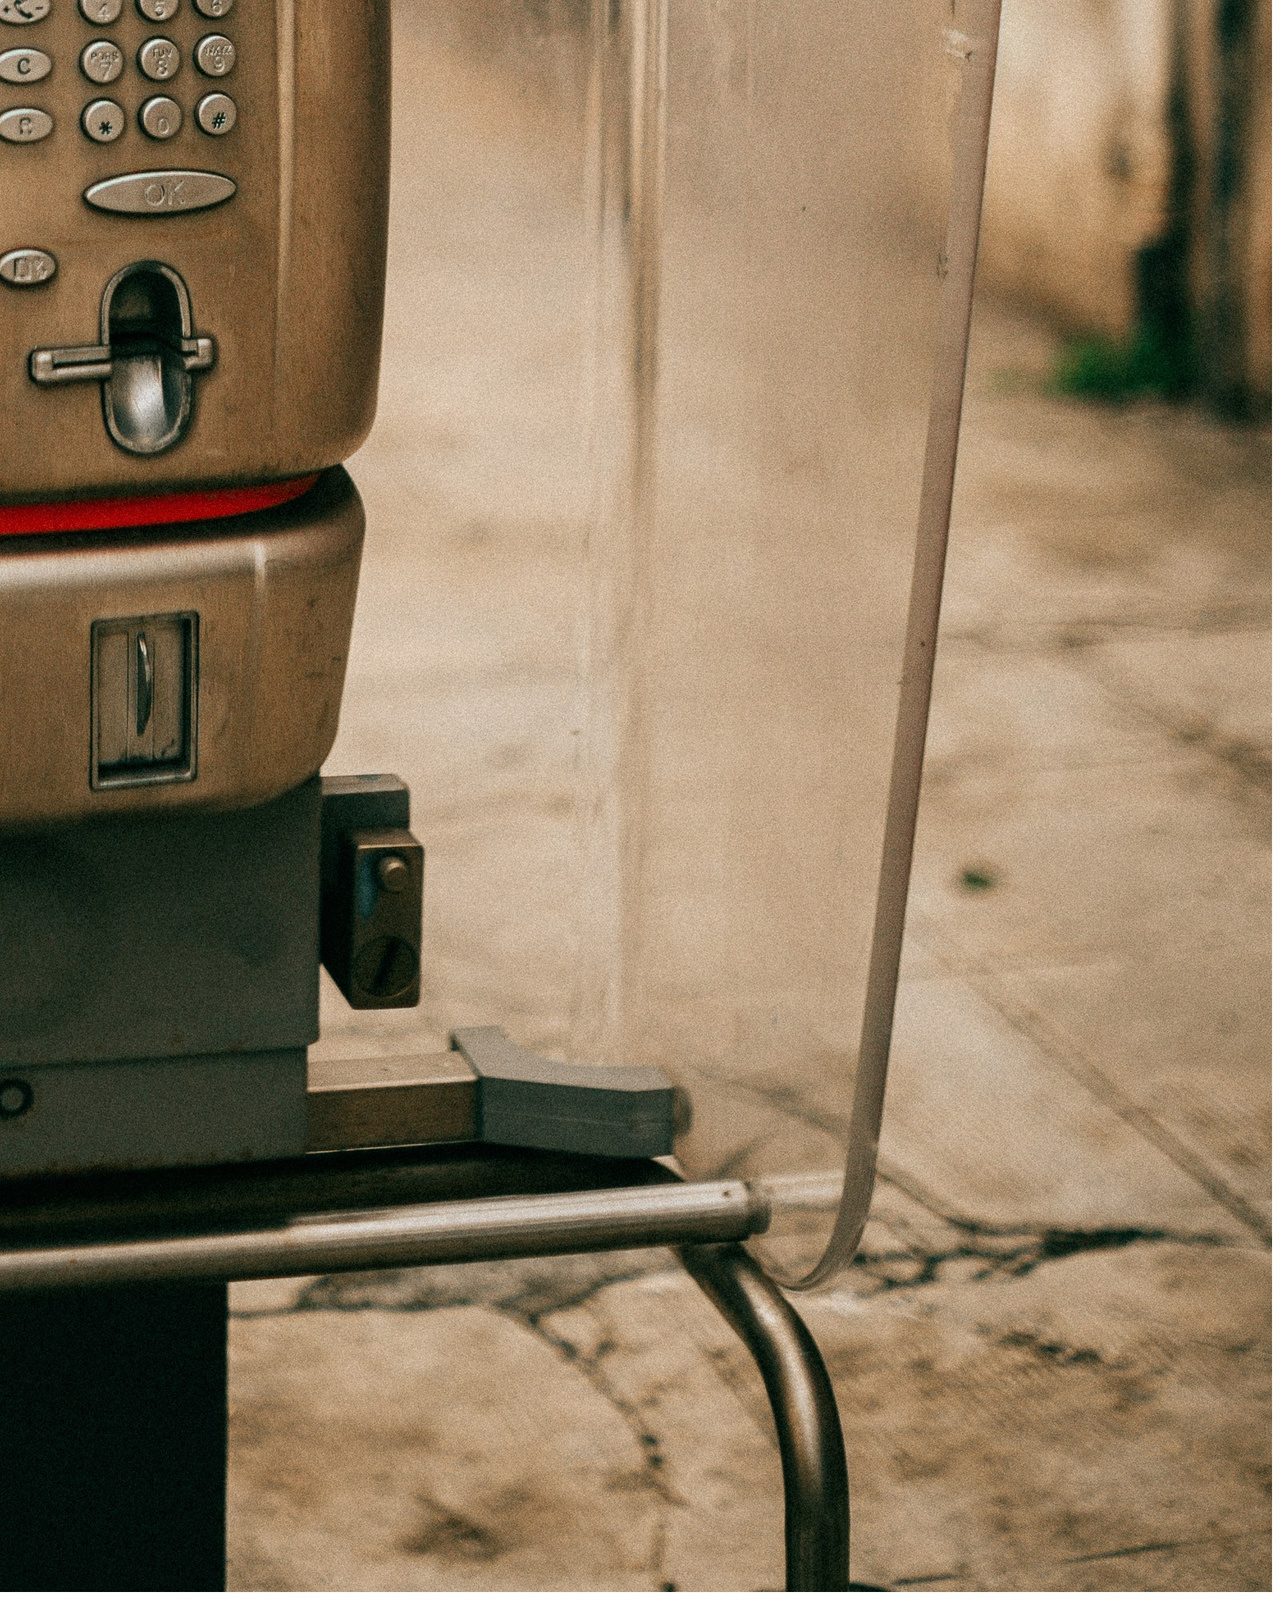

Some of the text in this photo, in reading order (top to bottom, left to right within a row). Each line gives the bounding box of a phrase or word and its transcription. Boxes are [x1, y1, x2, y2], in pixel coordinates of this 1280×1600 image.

[153, 1, 167, 18] 5
[17, 57, 31, 75] C
[99, 61, 114, 80] 7
[156, 58, 169, 77] 8
[213, 55, 225, 73] 9
[156, 117, 170, 135] 0
[211, 111, 227, 130] #
[144, 180, 185, 206] OK
